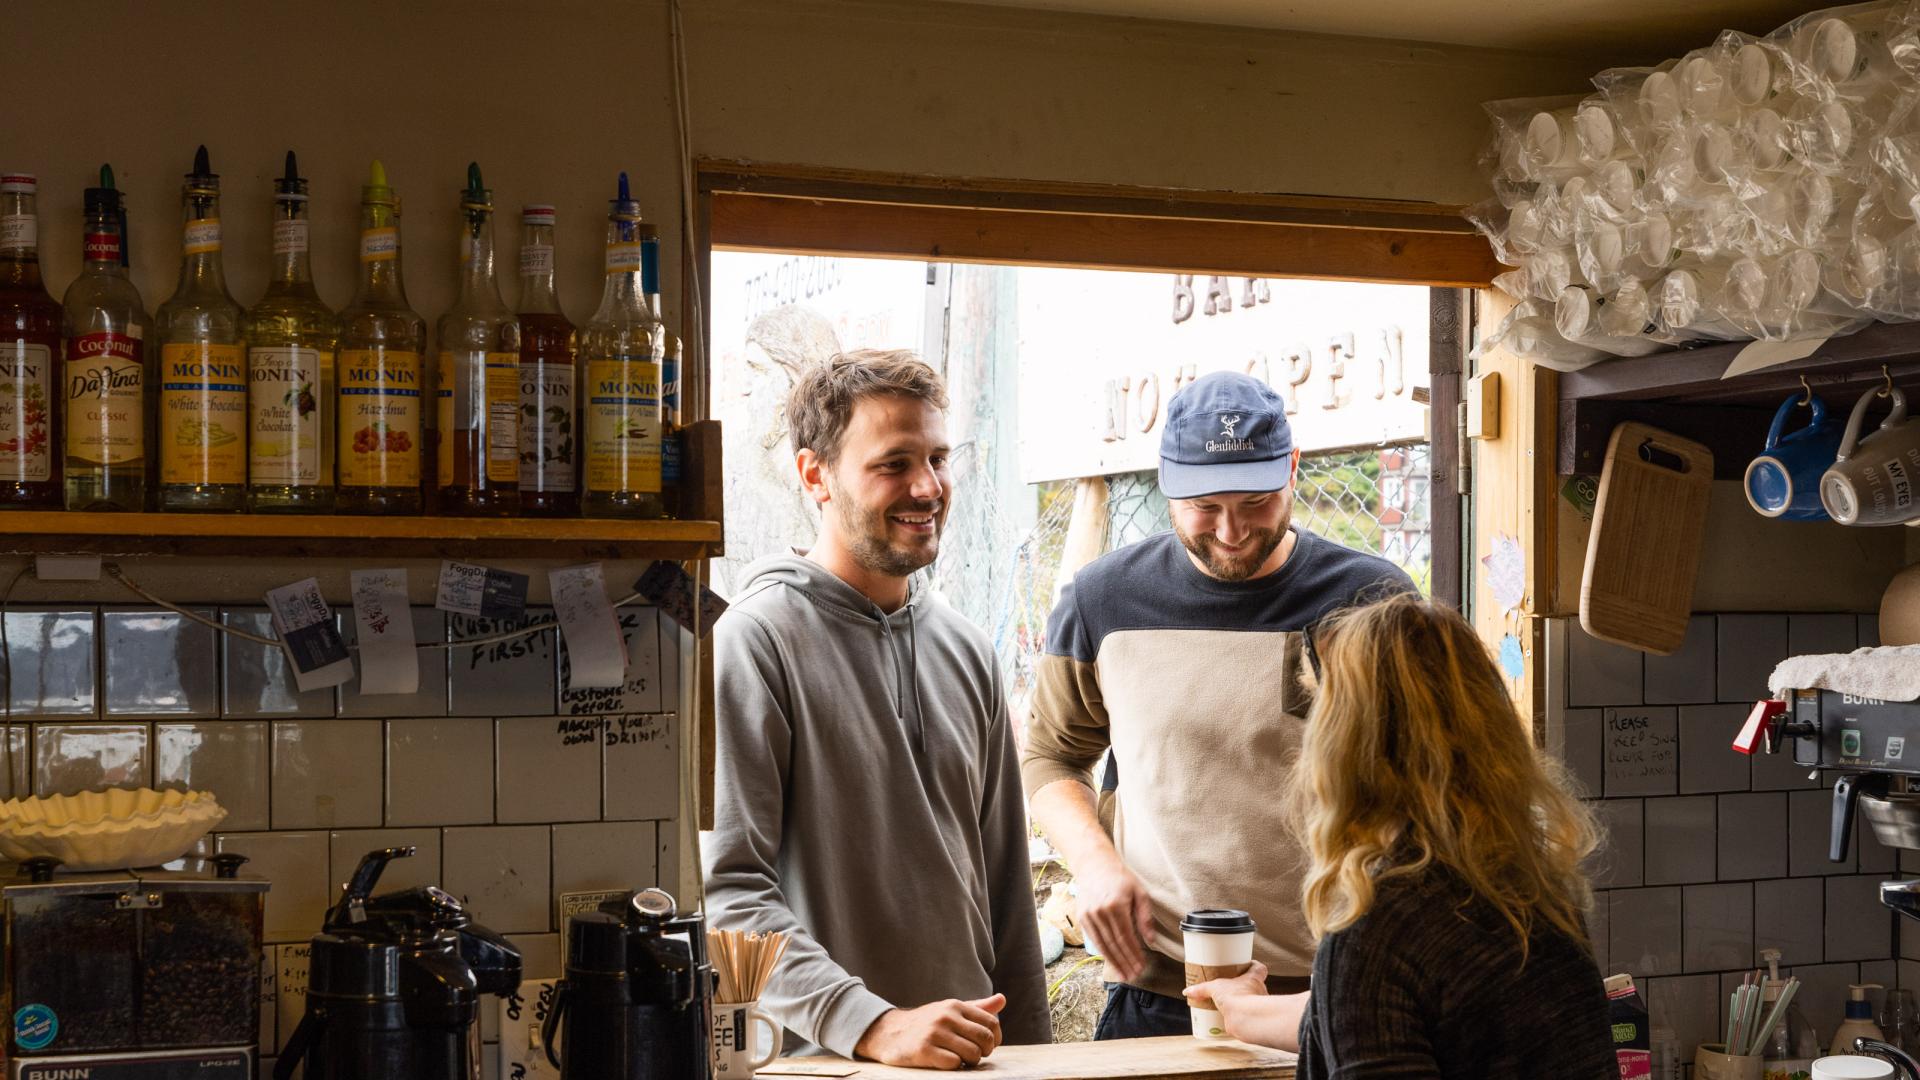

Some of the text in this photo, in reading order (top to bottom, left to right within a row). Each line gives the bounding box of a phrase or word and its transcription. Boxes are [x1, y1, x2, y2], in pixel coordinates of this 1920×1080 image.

[84, 242, 120, 253] Coconut
[78, 338, 135, 356] Coconut
[172, 363, 241, 378] MONIN
[349, 369, 414, 383] MONIN
[522, 382, 569, 397] ONIN
[87, 411, 129, 422] CLSSIC
[1205, 438, 1255, 453] Glenfiddich
[1888, 461, 1910, 506] MY EYES
[1608, 709, 1649, 731] PLEASE
